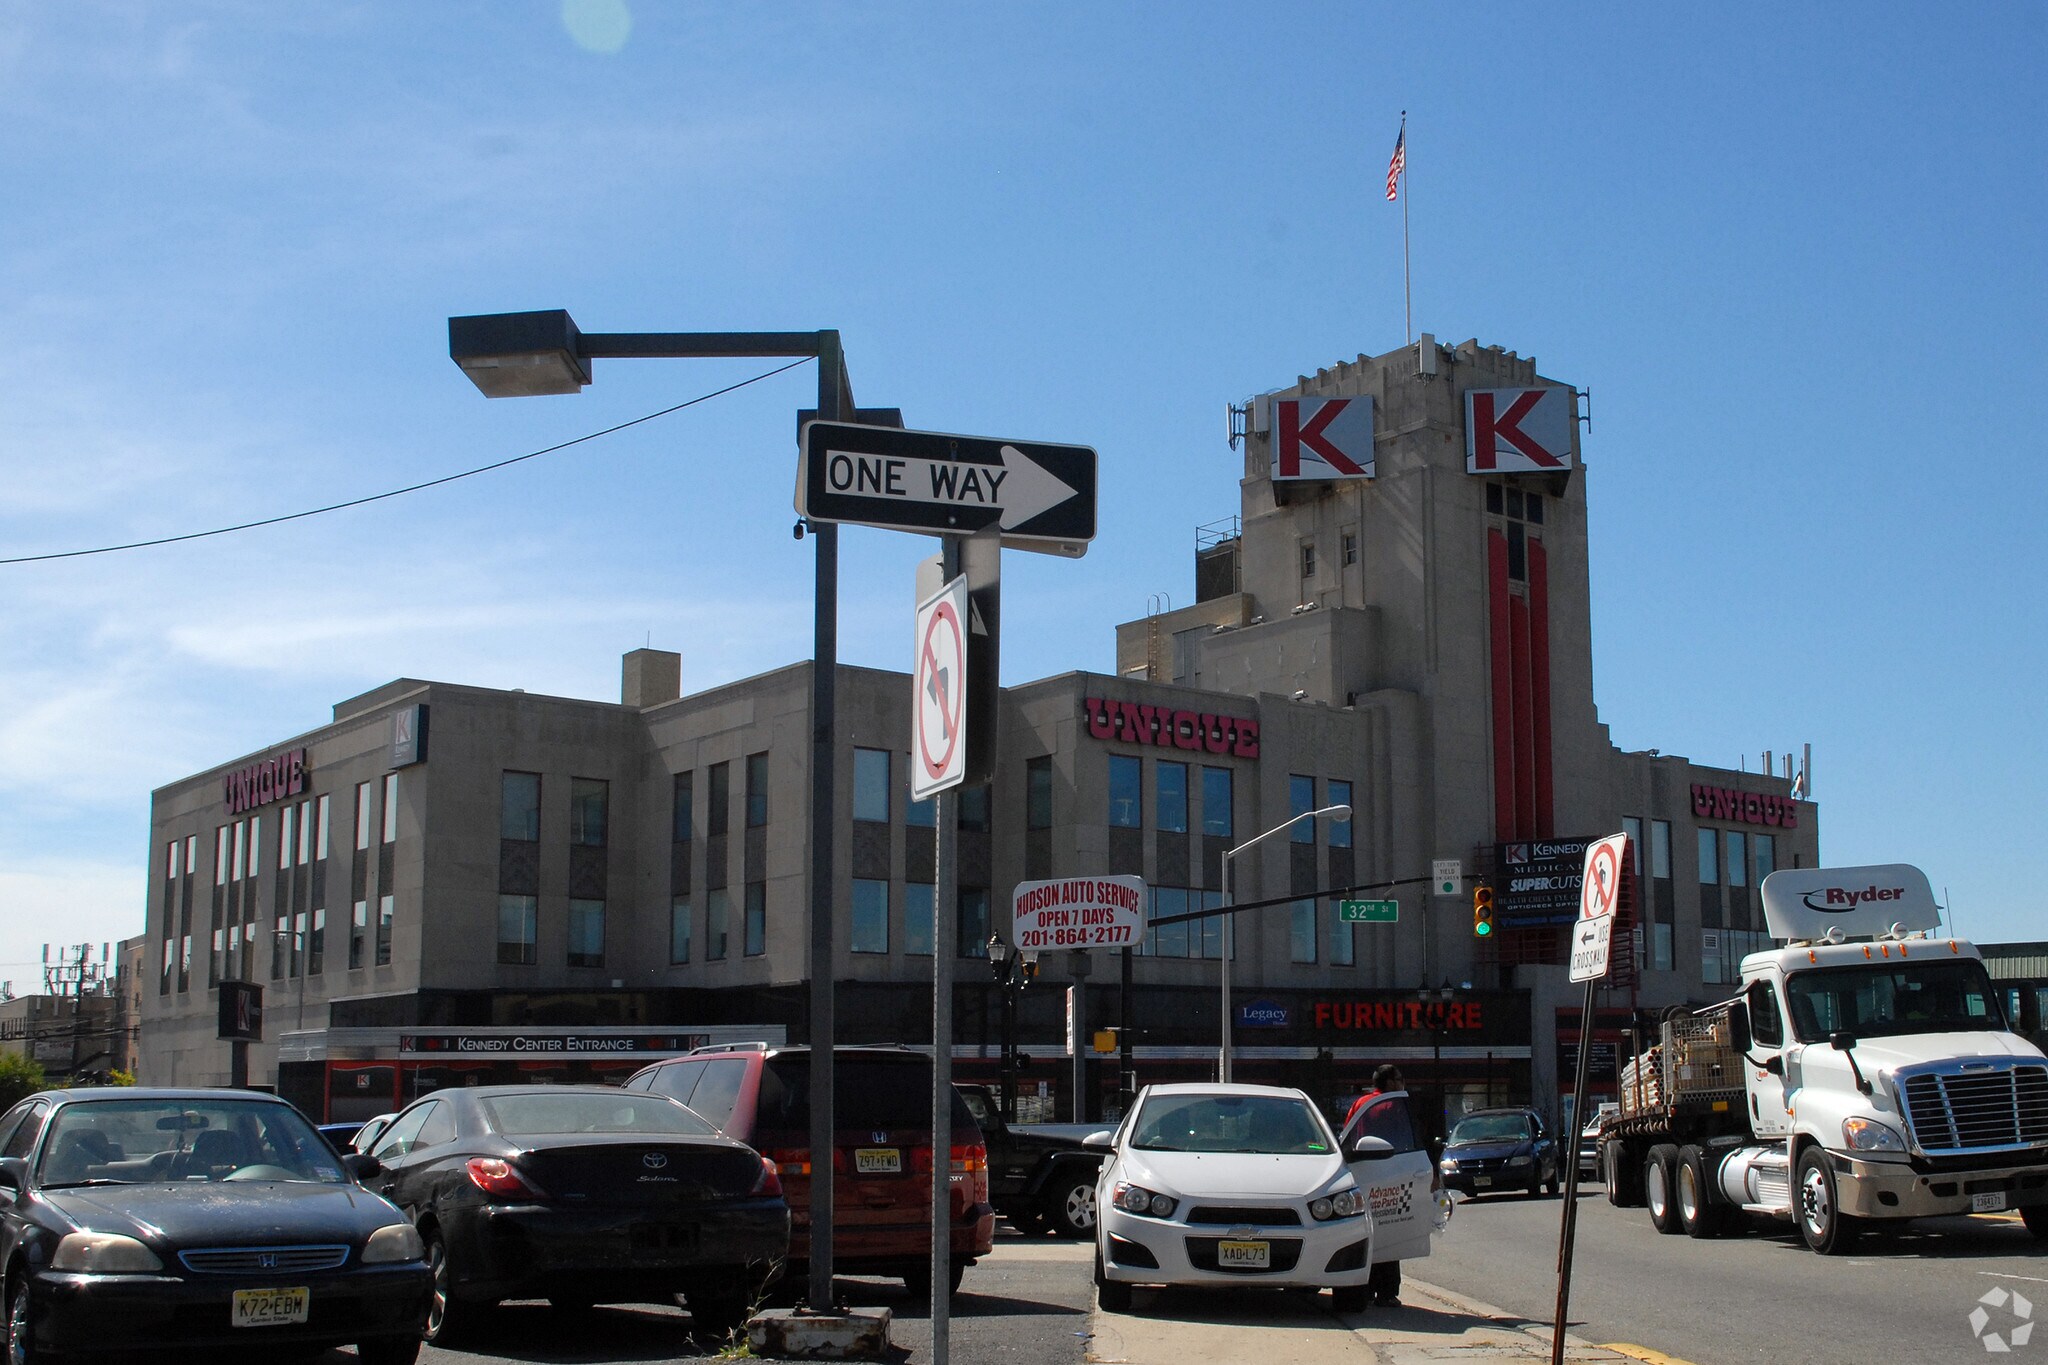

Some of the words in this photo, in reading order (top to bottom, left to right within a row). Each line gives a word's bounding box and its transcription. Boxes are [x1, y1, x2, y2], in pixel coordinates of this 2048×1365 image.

[1278, 399, 1368, 476] K
[1473, 390, 1564, 469] K
[829, 455, 907, 496] ONE
[930, 464, 1009, 503] WAY
[1087, 697, 1259, 758] UNIQUE
[223, 749, 303, 815] UNIQUE
[1691, 784, 1798, 828] UNIQUE
[1507, 845, 1526, 863] K
[1533, 843, 1587, 856] KENNEDY
[1510, 875, 1583, 892] SUPERCUTS
[1016, 884, 1060, 919] HUDSON
[1062, 881, 1094, 904] AUTO
[1097, 882, 1140, 915] SERVICE
[1826, 886, 1905, 906] Ryder
[1038, 910, 1069, 928] OPEN
[1072, 910, 1079, 925] 7
[1082, 907, 1115, 925] DAYS
[1599, 925, 1609, 943] USE
[1573, 947, 1607, 970] CROSSWALK
[1243, 1007, 1287, 1021] Legacy
[1314, 1002, 1483, 1029] FURNITURE
[457, 1037, 510, 1051] KENNEDY
[512, 1037, 562, 1051] CENTER
[566, 1037, 634, 1050] ENTRANCE
[1369, 1186, 1400, 1199] Advance
[1382, 1197, 1399, 1208] Parts
